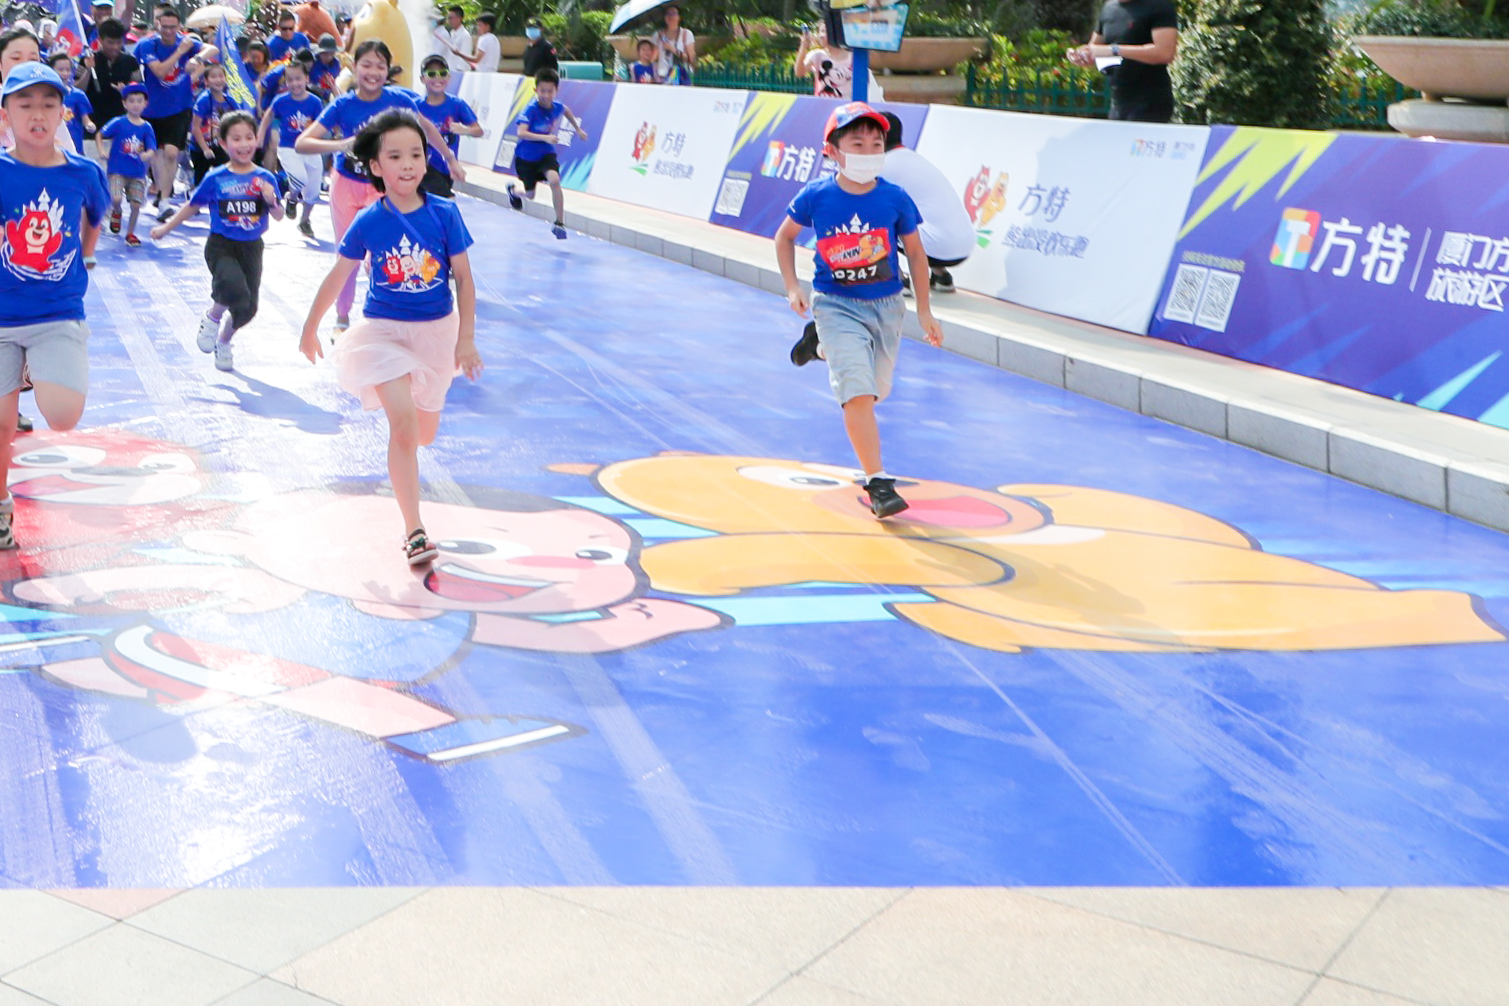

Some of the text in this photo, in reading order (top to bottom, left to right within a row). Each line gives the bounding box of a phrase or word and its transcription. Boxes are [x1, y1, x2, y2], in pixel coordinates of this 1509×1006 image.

[776, 144, 817, 183] 方特
[226, 200, 257, 214] A198
[1017, 182, 1071, 223] 方特
[1310, 217, 1410, 286] 方特
[1425, 266, 1509, 312] 旅游区
